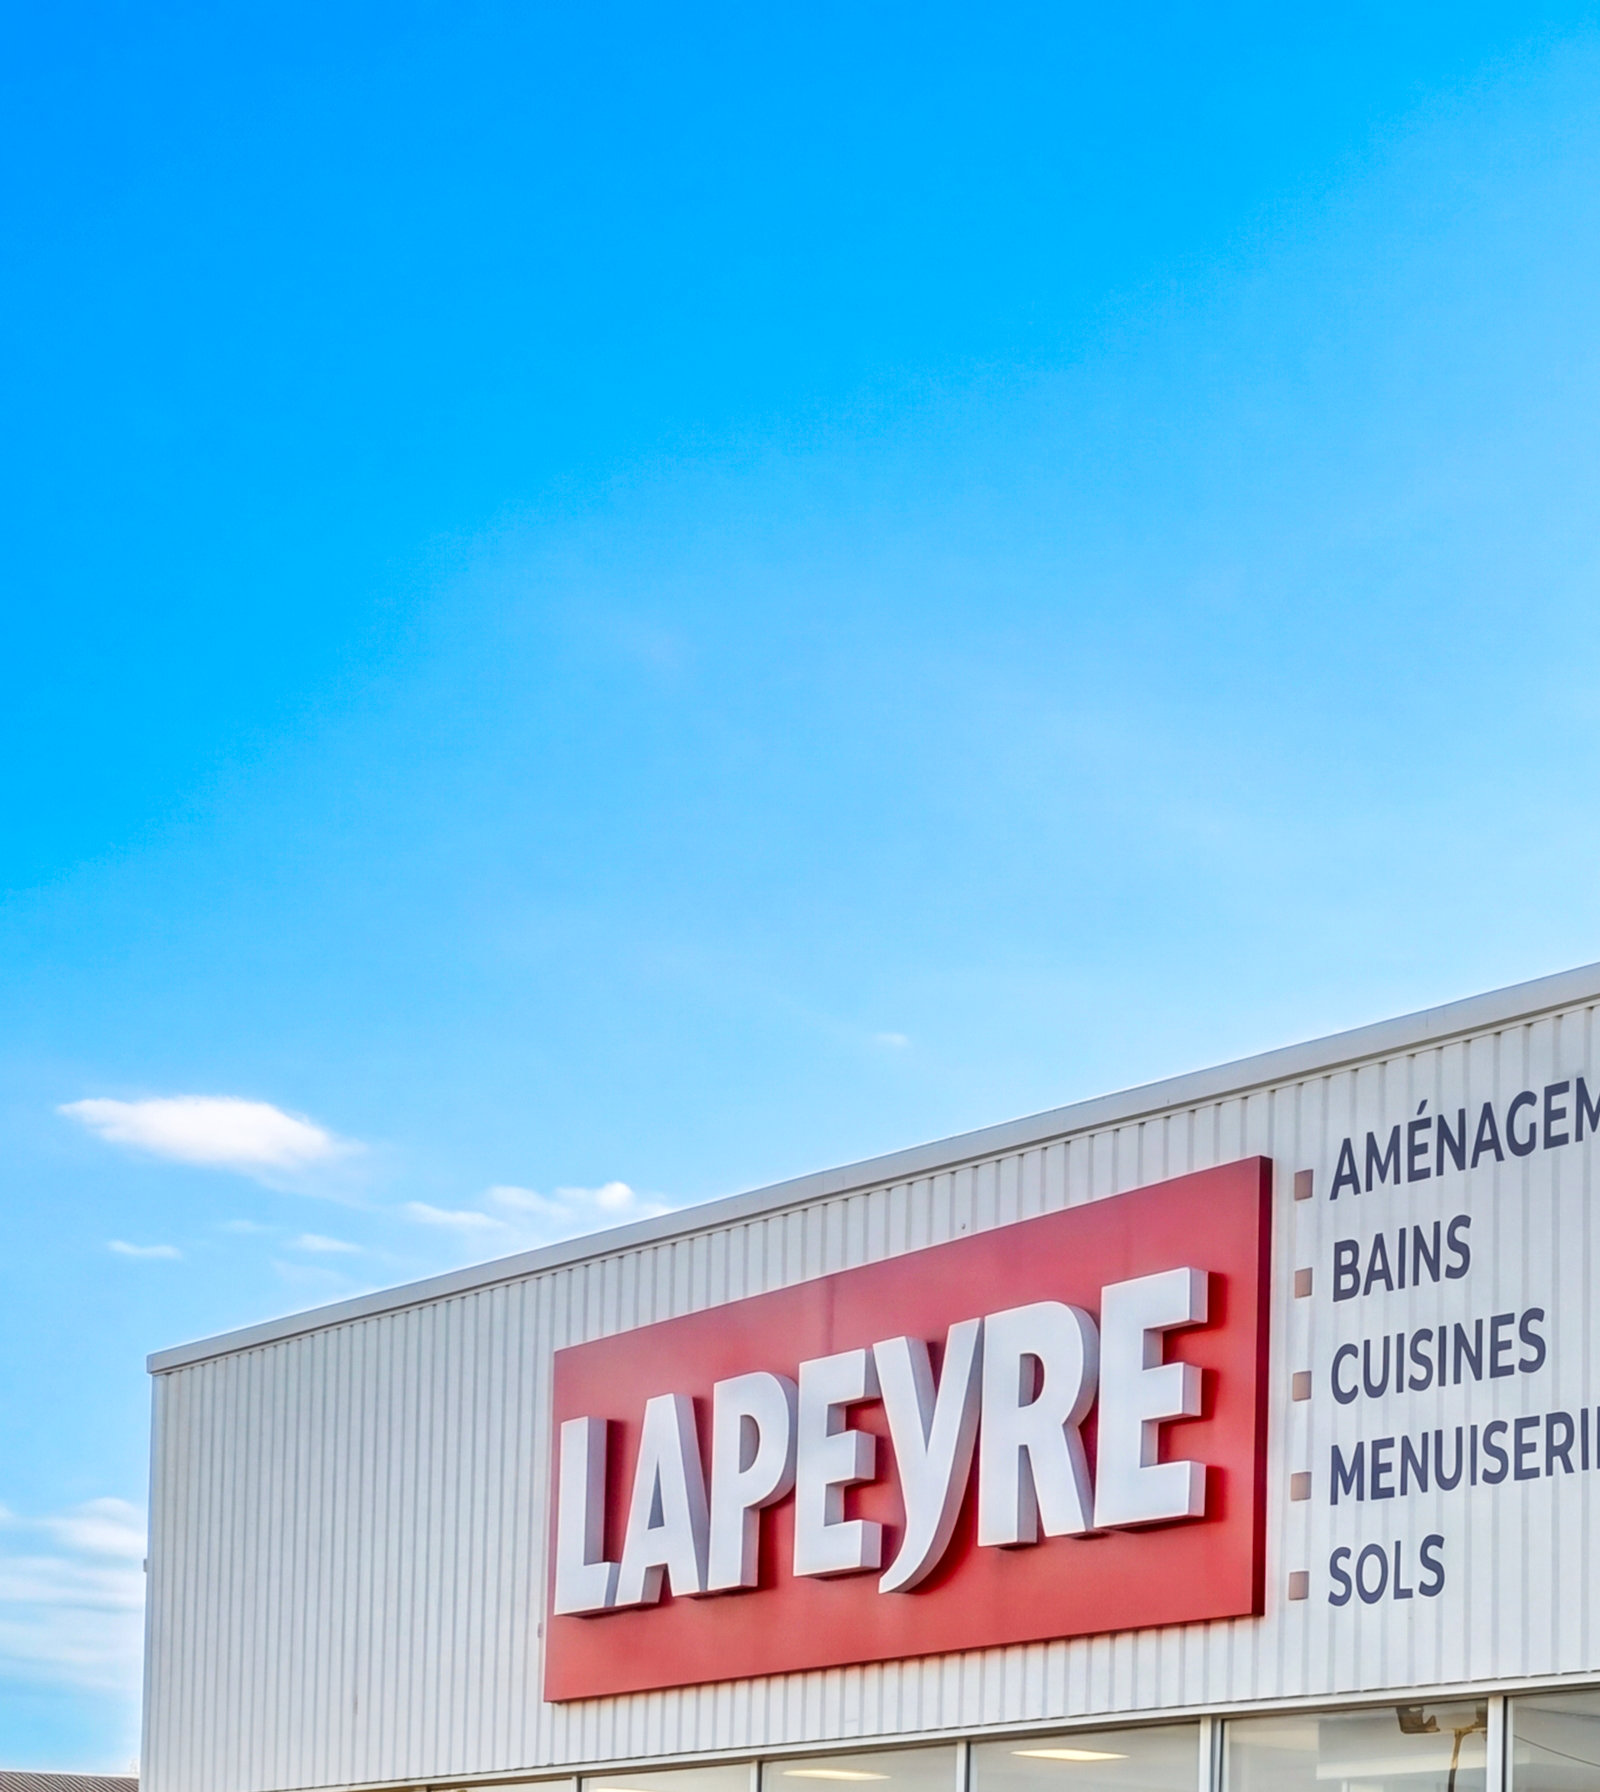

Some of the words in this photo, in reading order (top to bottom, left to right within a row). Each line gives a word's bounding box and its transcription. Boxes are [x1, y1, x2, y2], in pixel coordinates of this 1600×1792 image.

[1332, 1214, 1472, 1302] BAINS
[1331, 1308, 1547, 1404] CUISINES
[1328, 1533, 1446, 1606] SOLS
